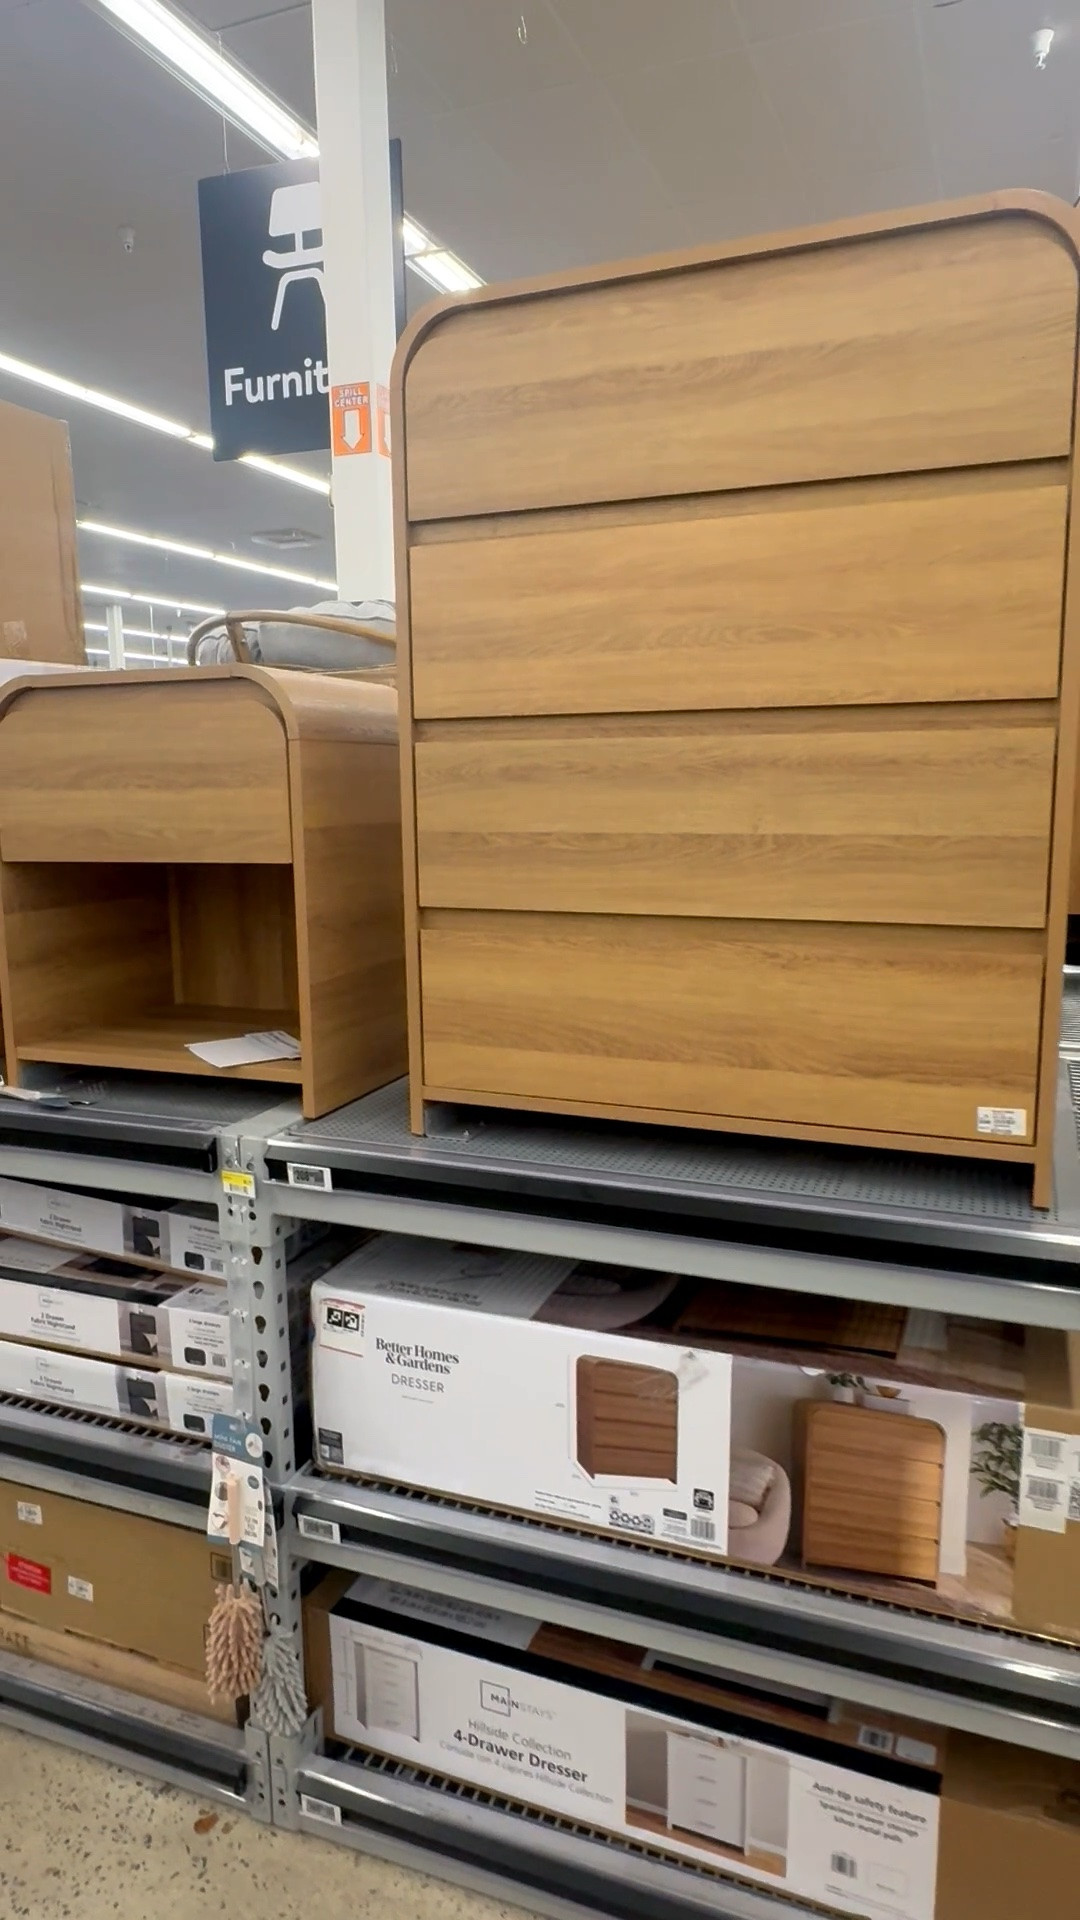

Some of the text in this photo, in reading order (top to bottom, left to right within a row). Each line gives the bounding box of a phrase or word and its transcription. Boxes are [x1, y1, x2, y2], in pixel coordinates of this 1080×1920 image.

[224, 357, 329, 405] Furnit
[339, 386, 364, 398] SPILL
[335, 395, 369, 407] CENTER
[376, 1337, 459, 1364] Better Homes
[385, 1352, 451, 1375] & Gardens
[391, 1373, 444, 1393] DRESSER
[490, 1693, 554, 1720] MAINSTAYS
[468, 1719, 572, 1761] Hillside Collection
[453, 1729, 588, 1783] 4-Drawer Dresser
